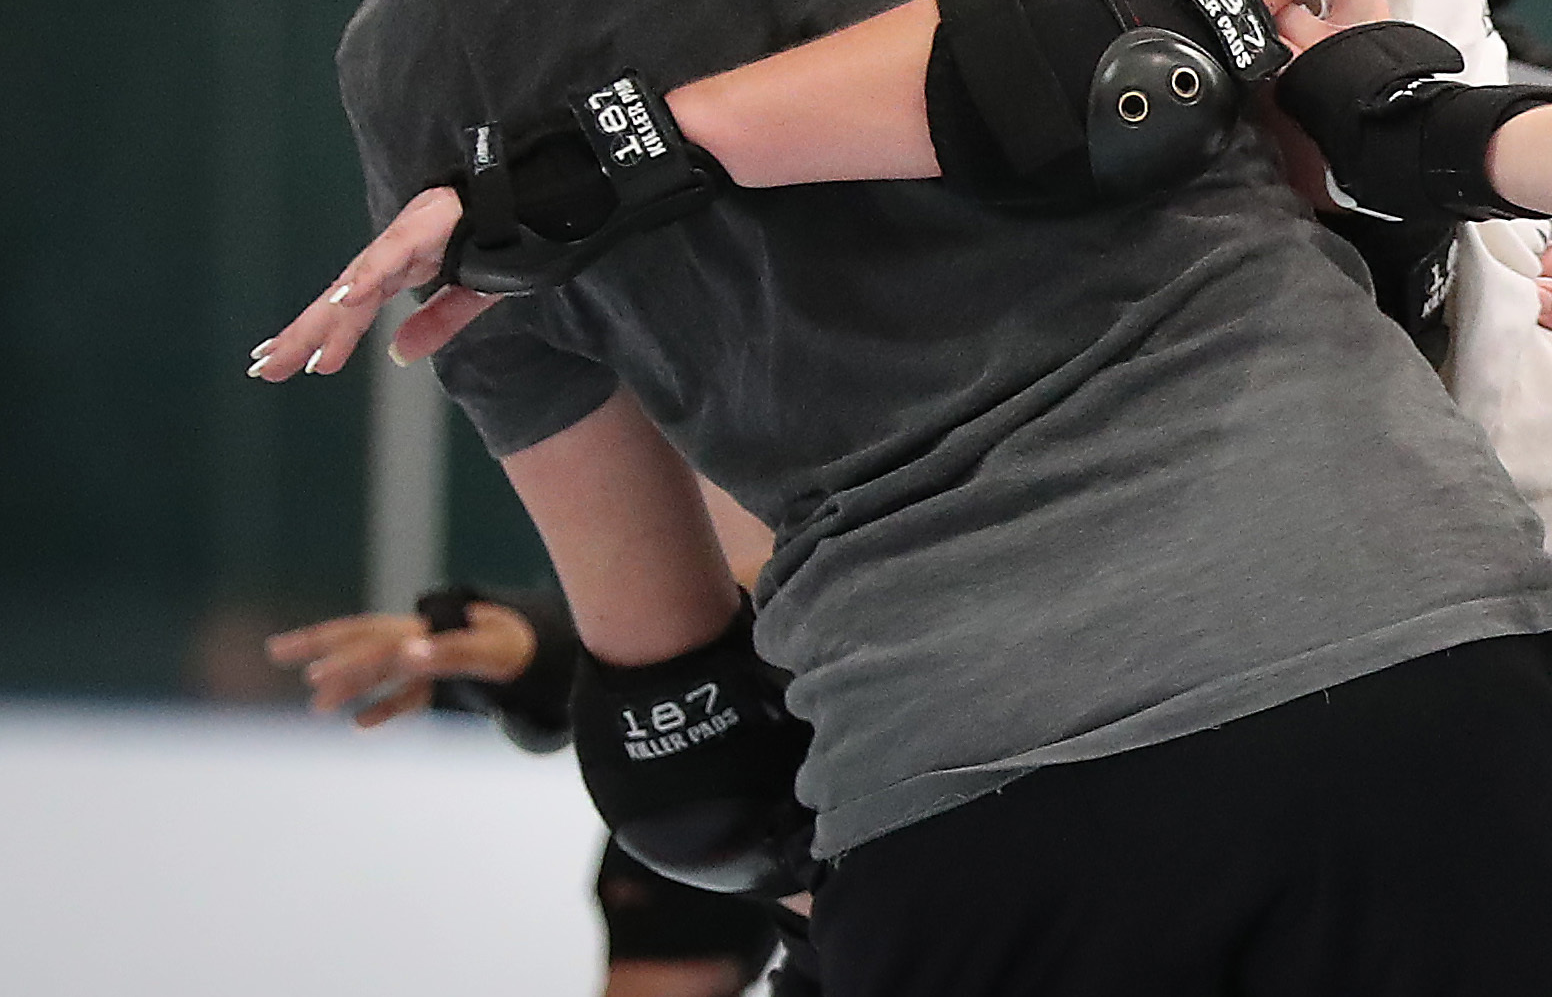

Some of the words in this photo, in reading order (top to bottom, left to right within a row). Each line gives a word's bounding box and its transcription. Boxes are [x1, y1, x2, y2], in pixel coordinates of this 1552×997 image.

[1217, 15, 1253, 69] PADS
[588, 91, 644, 161] 187
[627, 101, 667, 158] KILLER
[622, 682, 720, 739] 187
[624, 732, 688, 760] KILLER
[686, 707, 740, 744] PADS
